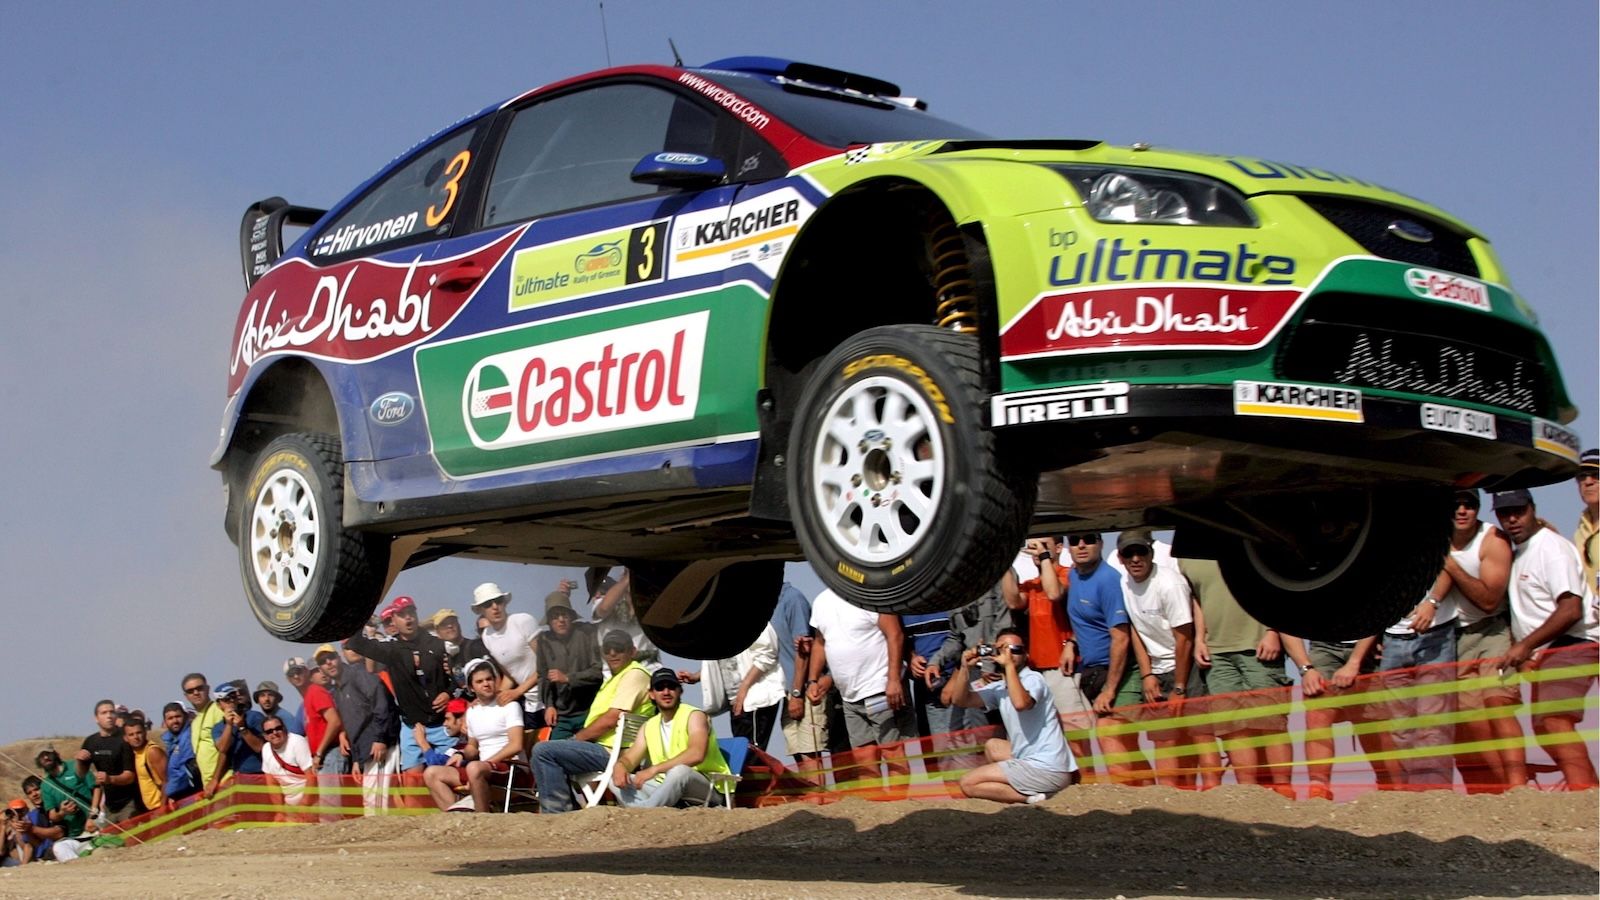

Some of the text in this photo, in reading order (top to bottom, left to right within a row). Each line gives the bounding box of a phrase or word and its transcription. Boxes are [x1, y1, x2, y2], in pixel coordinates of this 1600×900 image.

[678, 72, 770, 130] www.wrcford.com
[425, 150, 471, 227] 3
[329, 211, 418, 256] Hirvonen
[694, 198, 800, 247] KÄRCHER
[1049, 228, 1078, 250] bp
[637, 225, 656, 281] 3
[1049, 238, 1296, 287] ultimate
[514, 271, 569, 297] ultimate
[230, 290, 302, 376] Abu
[1047, 298, 1134, 341] Abu
[516, 328, 686, 433] Castrol
[992, 382, 1130, 428] PIRELLI
[376, 395, 407, 421] Ford
